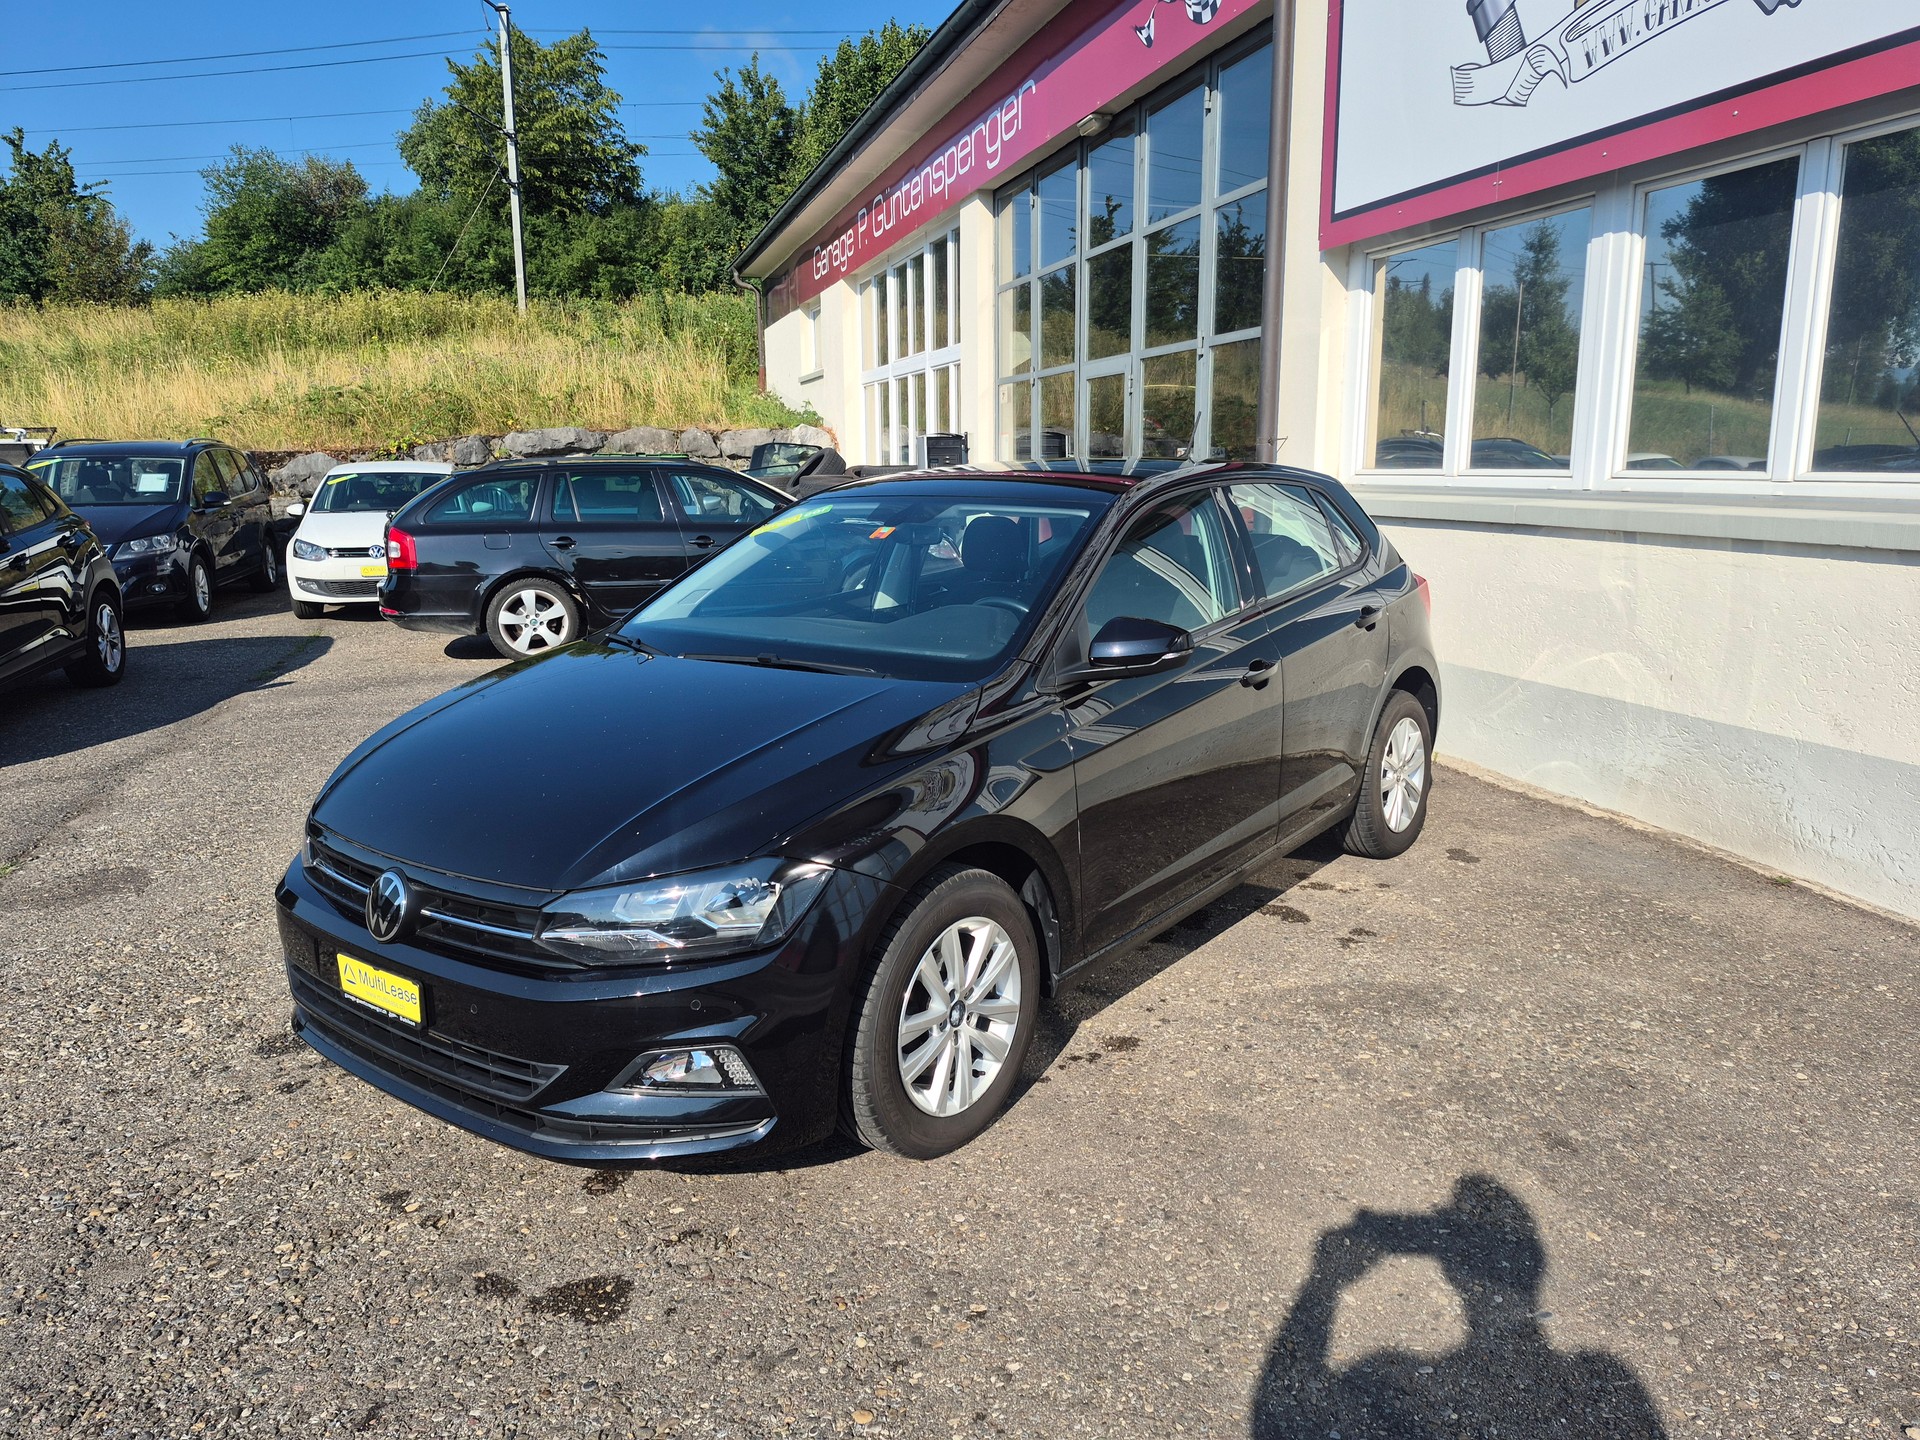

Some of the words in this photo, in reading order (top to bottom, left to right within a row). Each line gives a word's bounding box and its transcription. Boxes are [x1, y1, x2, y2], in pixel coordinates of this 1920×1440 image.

[813, 229, 855, 280] Garage
[872, 79, 1036, 238] Güntensperger
[358, 968, 418, 1006] MultiLease
